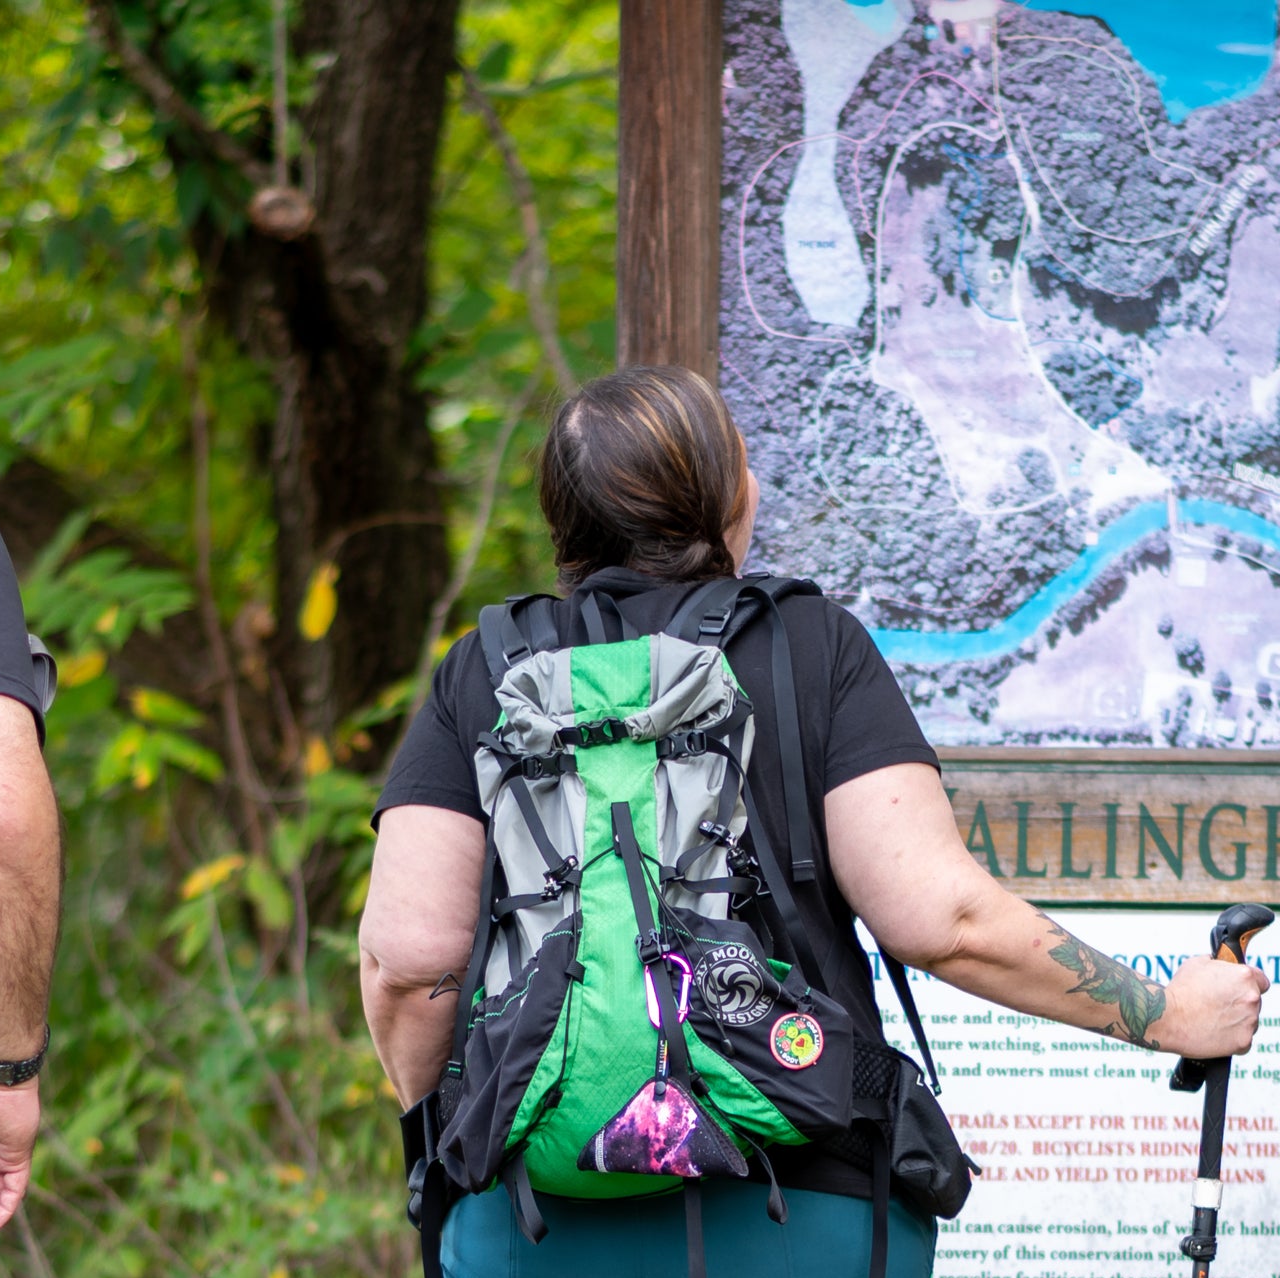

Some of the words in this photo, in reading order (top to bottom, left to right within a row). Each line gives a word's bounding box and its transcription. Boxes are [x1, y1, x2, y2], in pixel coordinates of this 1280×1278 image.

[931, 1013, 958, 1025] use
[963, 1010, 993, 1025] and
[969, 1037, 1046, 1056] watching,
[952, 1063, 982, 1077] and
[986, 1066, 1044, 1077] owners
[1049, 1065, 1088, 1078] must
[1094, 1064, 1136, 1078] clean
[1140, 1067, 1161, 1082] up
[948, 1114, 1008, 1129] TRAILS
[1014, 1114, 1085, 1130] EXCEPT
[1089, 1115, 1125, 1130] FOR
[1130, 1116, 1168, 1130] THE
[1226, 1116, 1278, 1132] TRAIL
[1032, 1141, 1135, 1157] BICYCLISTS
[1242, 1143, 1280, 1158] THE
[1012, 1167, 1050, 1182] AND
[1054, 1167, 1108, 1183] YIELD
[1113, 1168, 1138, 1183] TO
[964, 1223, 993, 1234] can
[997, 1223, 1043, 1235] cause
[1047, 1220, 1113, 1238] erosion,
[1116, 1220, 1148, 1235] loss
[1152, 1220, 1170, 1235] of
[993, 1245, 1011, 1260] of
[1016, 1246, 1046, 1260] this
[1050, 1246, 1154, 1261] conservation
